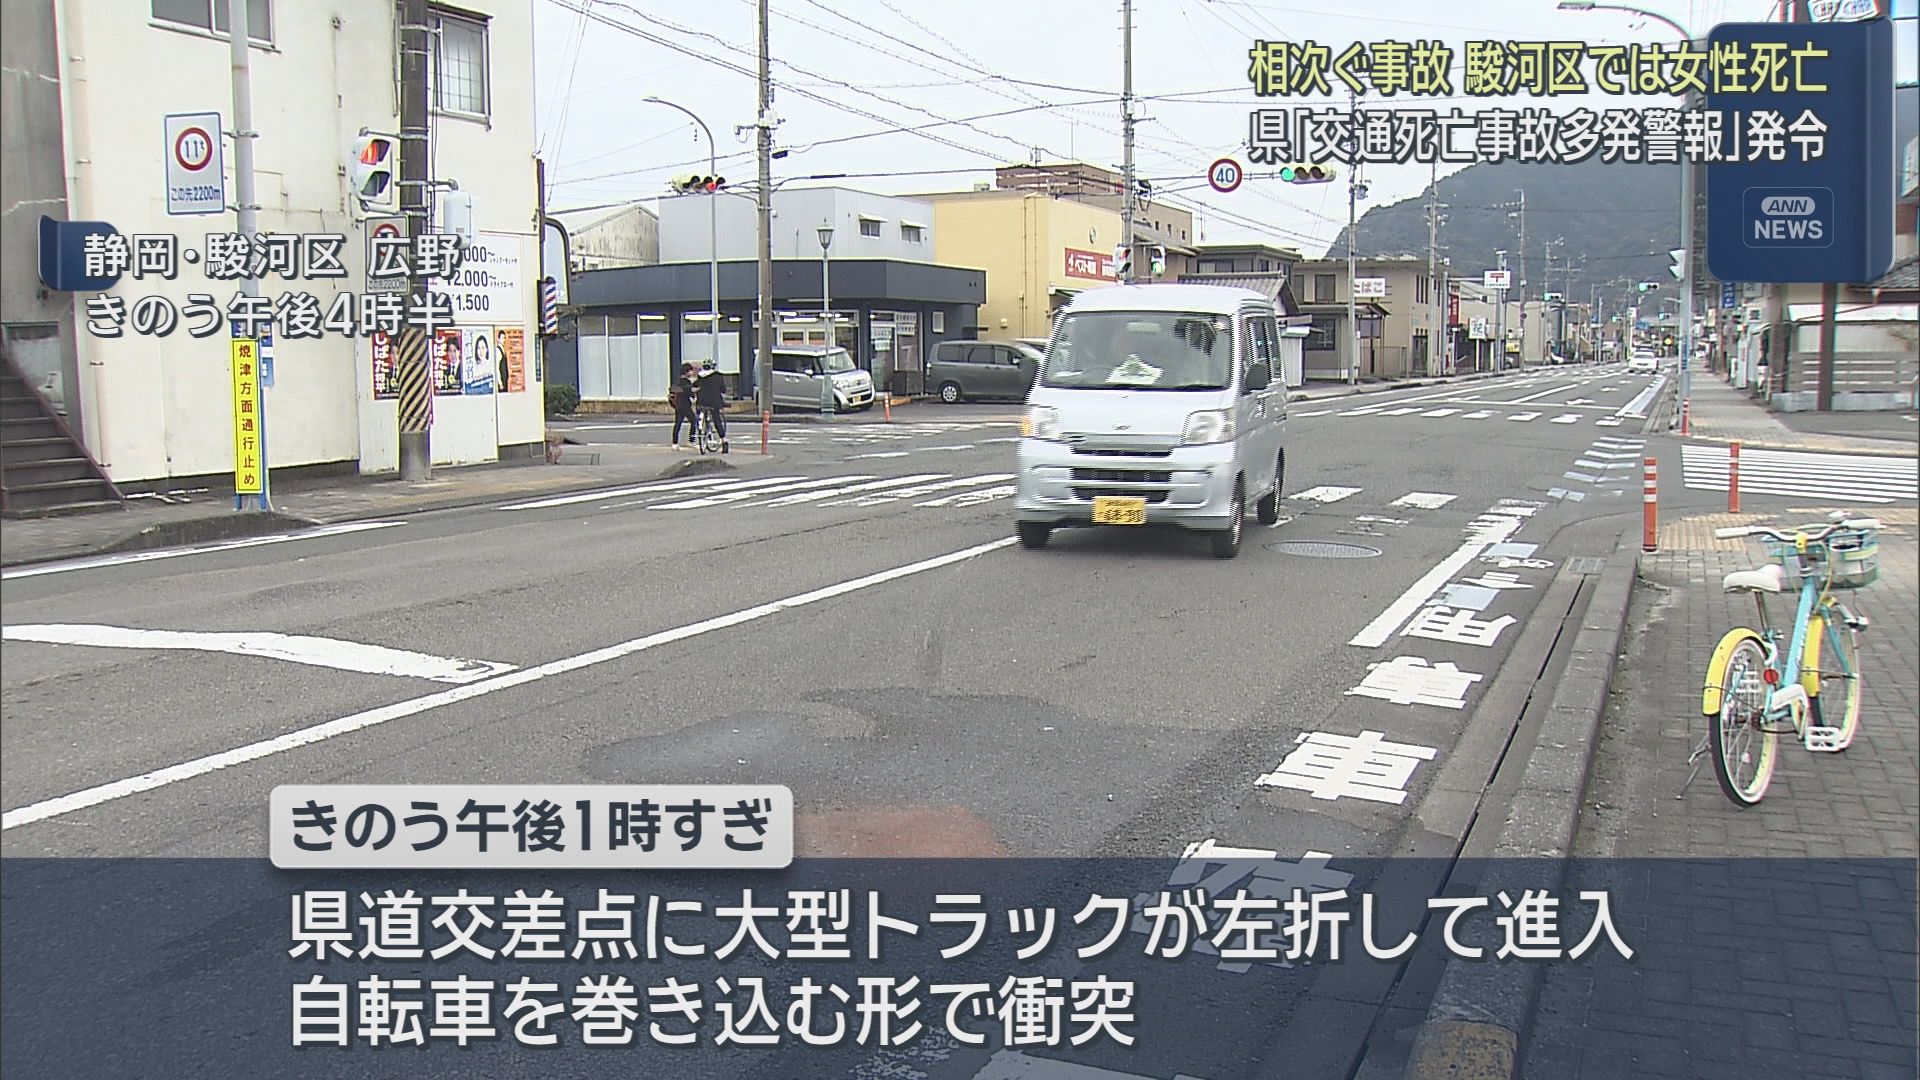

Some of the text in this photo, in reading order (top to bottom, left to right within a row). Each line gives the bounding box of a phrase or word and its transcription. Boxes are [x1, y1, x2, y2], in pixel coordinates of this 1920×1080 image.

[1215, 167, 1235, 183] 40
[171, 186, 221, 201] この先2200m
[239, 344, 255, 486] 焼津方面通行止め
